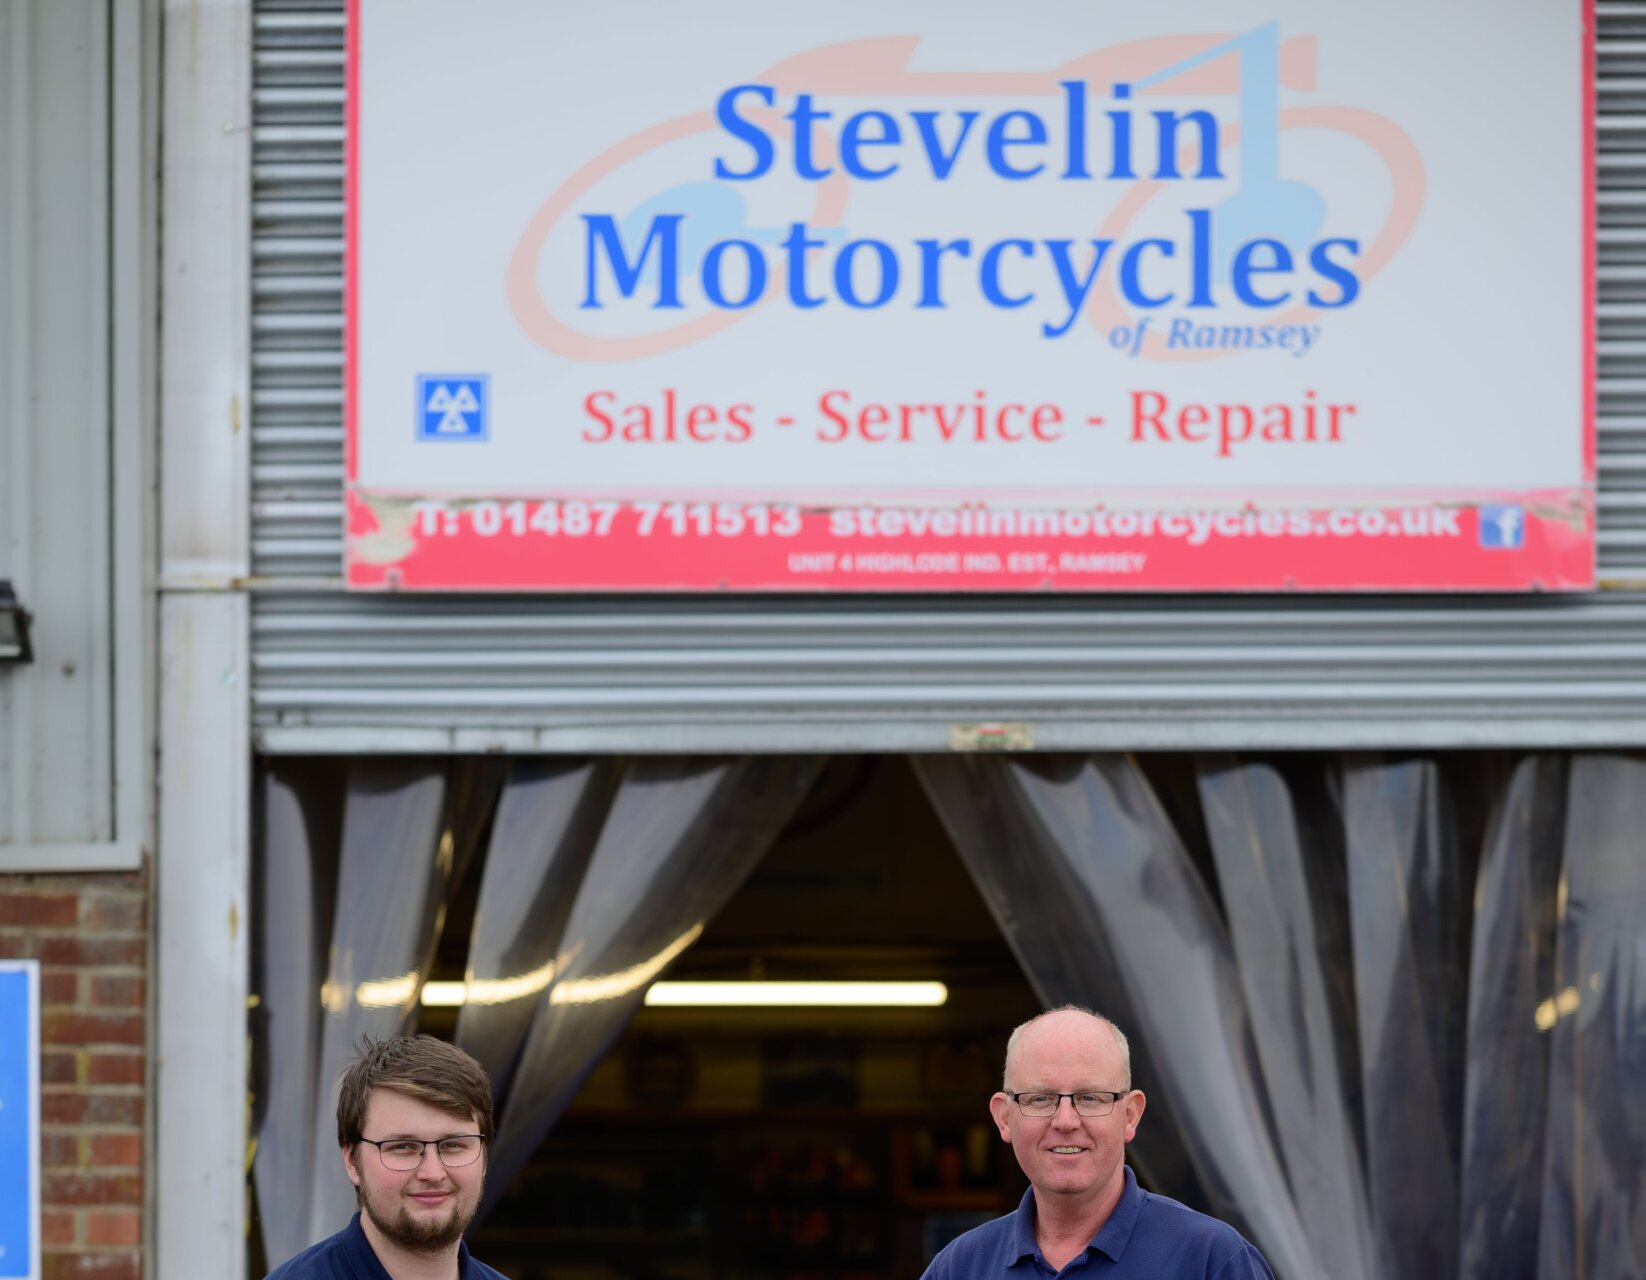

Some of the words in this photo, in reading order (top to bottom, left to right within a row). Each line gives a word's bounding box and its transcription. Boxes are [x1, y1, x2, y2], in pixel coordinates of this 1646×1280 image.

[713, 81, 1224, 181] Stevelin
[579, 209, 1361, 341] Motorcycles
[1109, 317, 1149, 357] of
[1166, 318, 1321, 358] Ramsey
[582, 389, 755, 444] Sales
[816, 389, 1065, 444] Service
[1129, 389, 1359, 459] Repair
[418, 500, 460, 538] T:
[472, 500, 619, 538] 01487
[633, 500, 803, 538] 711513
[787, 553, 836, 574] UNIT
[839, 553, 853, 574] 4
[1060, 554, 1148, 575] RAMSEY
